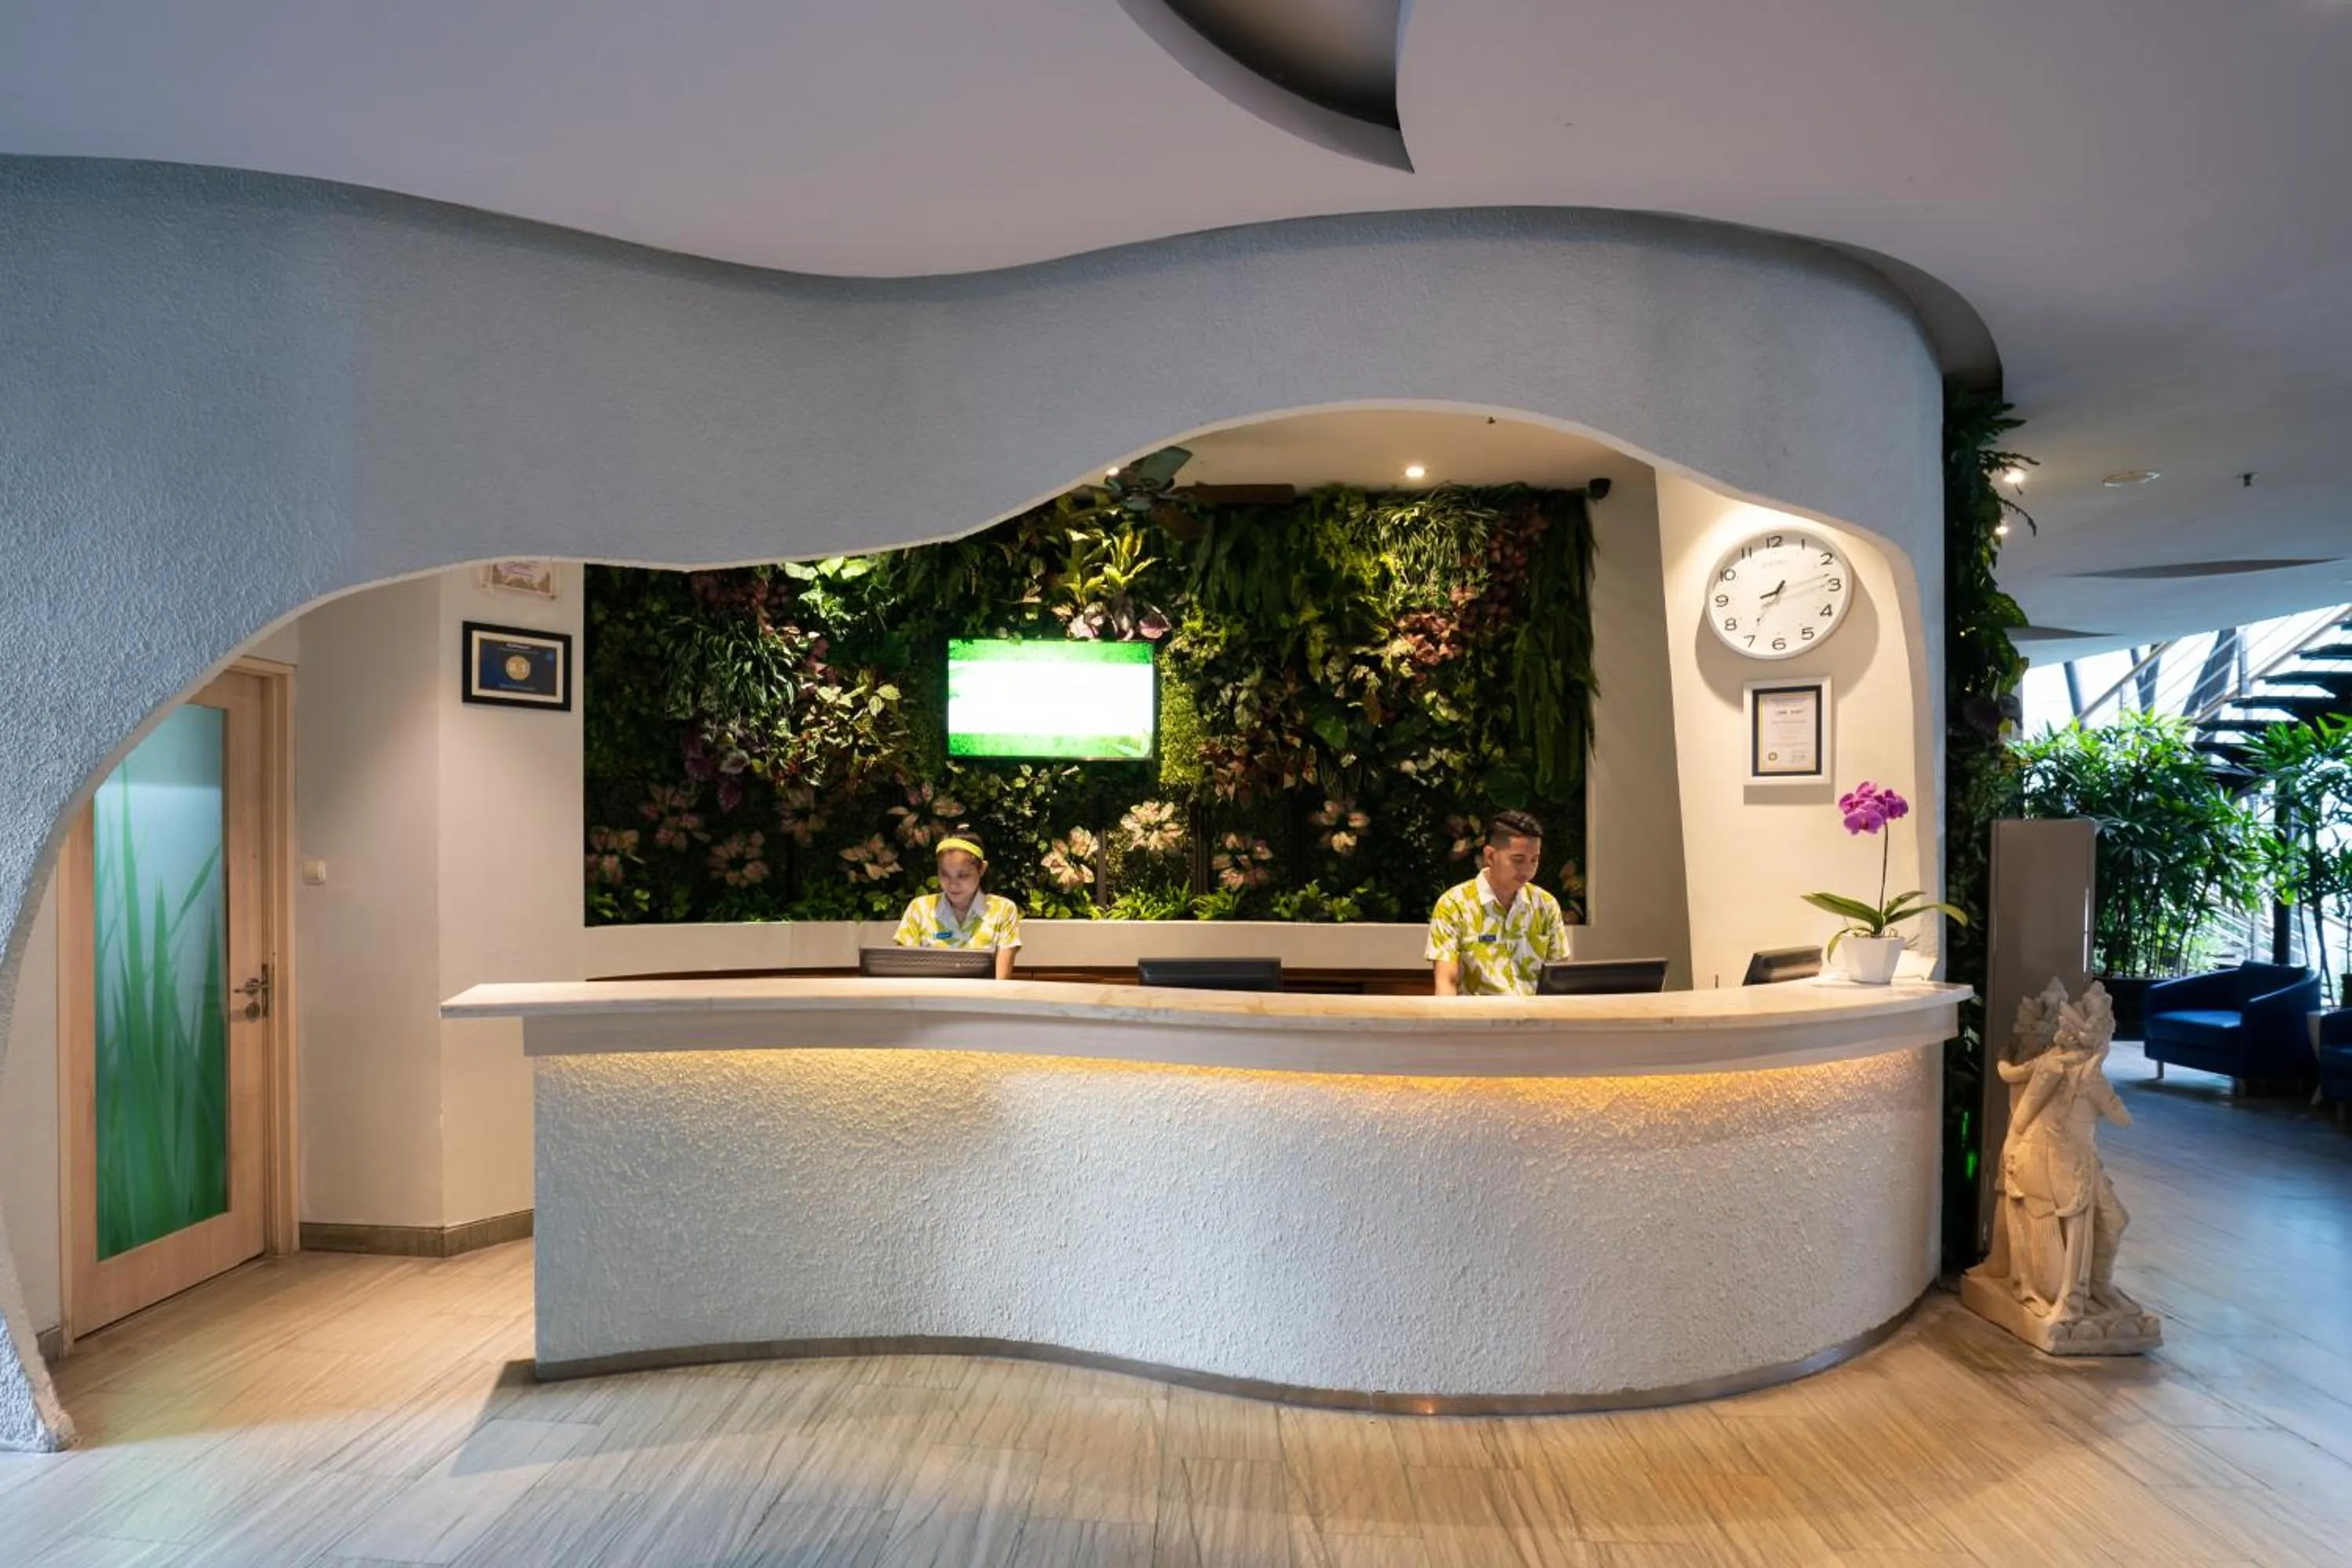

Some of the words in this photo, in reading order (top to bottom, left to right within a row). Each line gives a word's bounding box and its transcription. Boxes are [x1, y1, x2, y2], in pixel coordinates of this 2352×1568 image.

[1766, 535, 1783, 549] 12
[1802, 539, 1806, 550] 1
[1741, 546, 1752, 559] 11
[1820, 552, 1833, 565] 2
[1719, 569, 1737, 582] 10
[1828, 579, 1841, 592] 3
[1715, 594, 1729, 608] 9
[1819, 604, 1833, 617] 4
[1725, 617, 1737, 630] 8
[1801, 626, 1815, 640] 5
[1743, 634, 1756, 648] 7
[1772, 638, 1787, 650] 6
